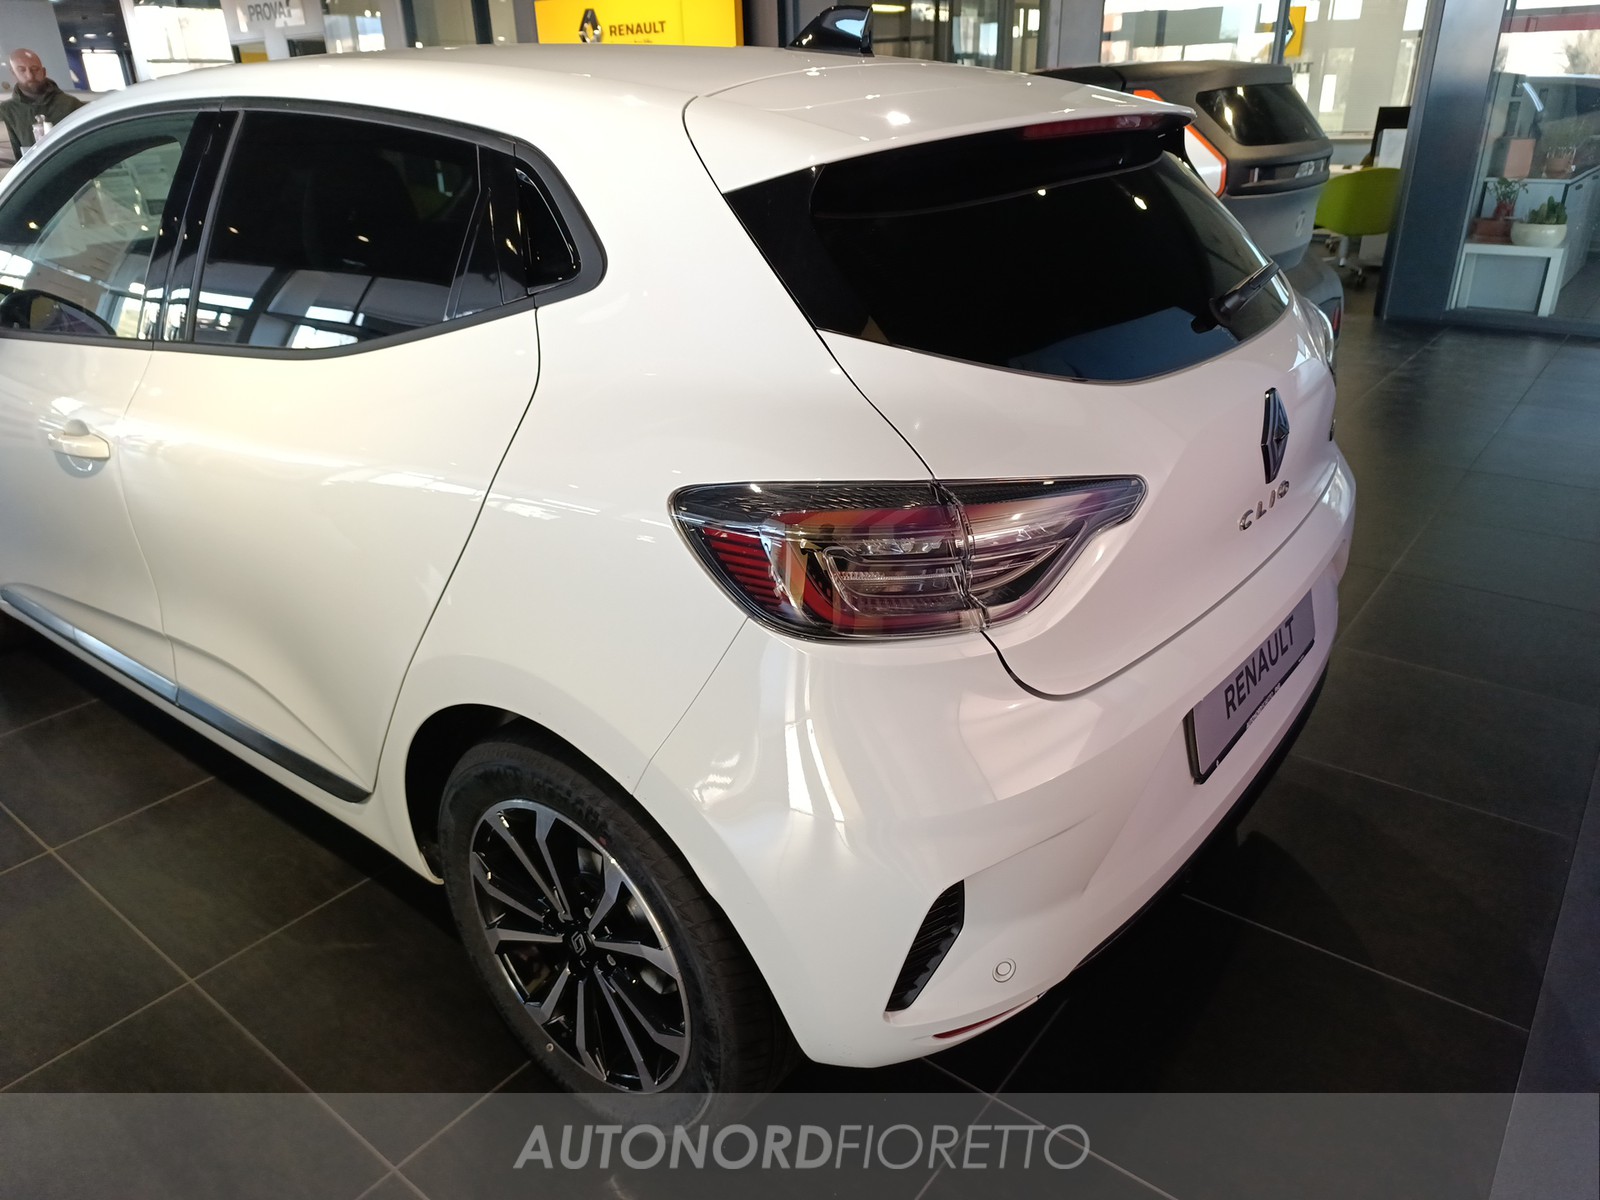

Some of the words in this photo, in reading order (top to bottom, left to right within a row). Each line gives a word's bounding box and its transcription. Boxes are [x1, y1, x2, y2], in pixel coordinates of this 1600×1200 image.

[608, 20, 667, 37] RENAULT
[1239, 480, 1290, 531] CLIO
[1223, 614, 1294, 720] RENAULT
